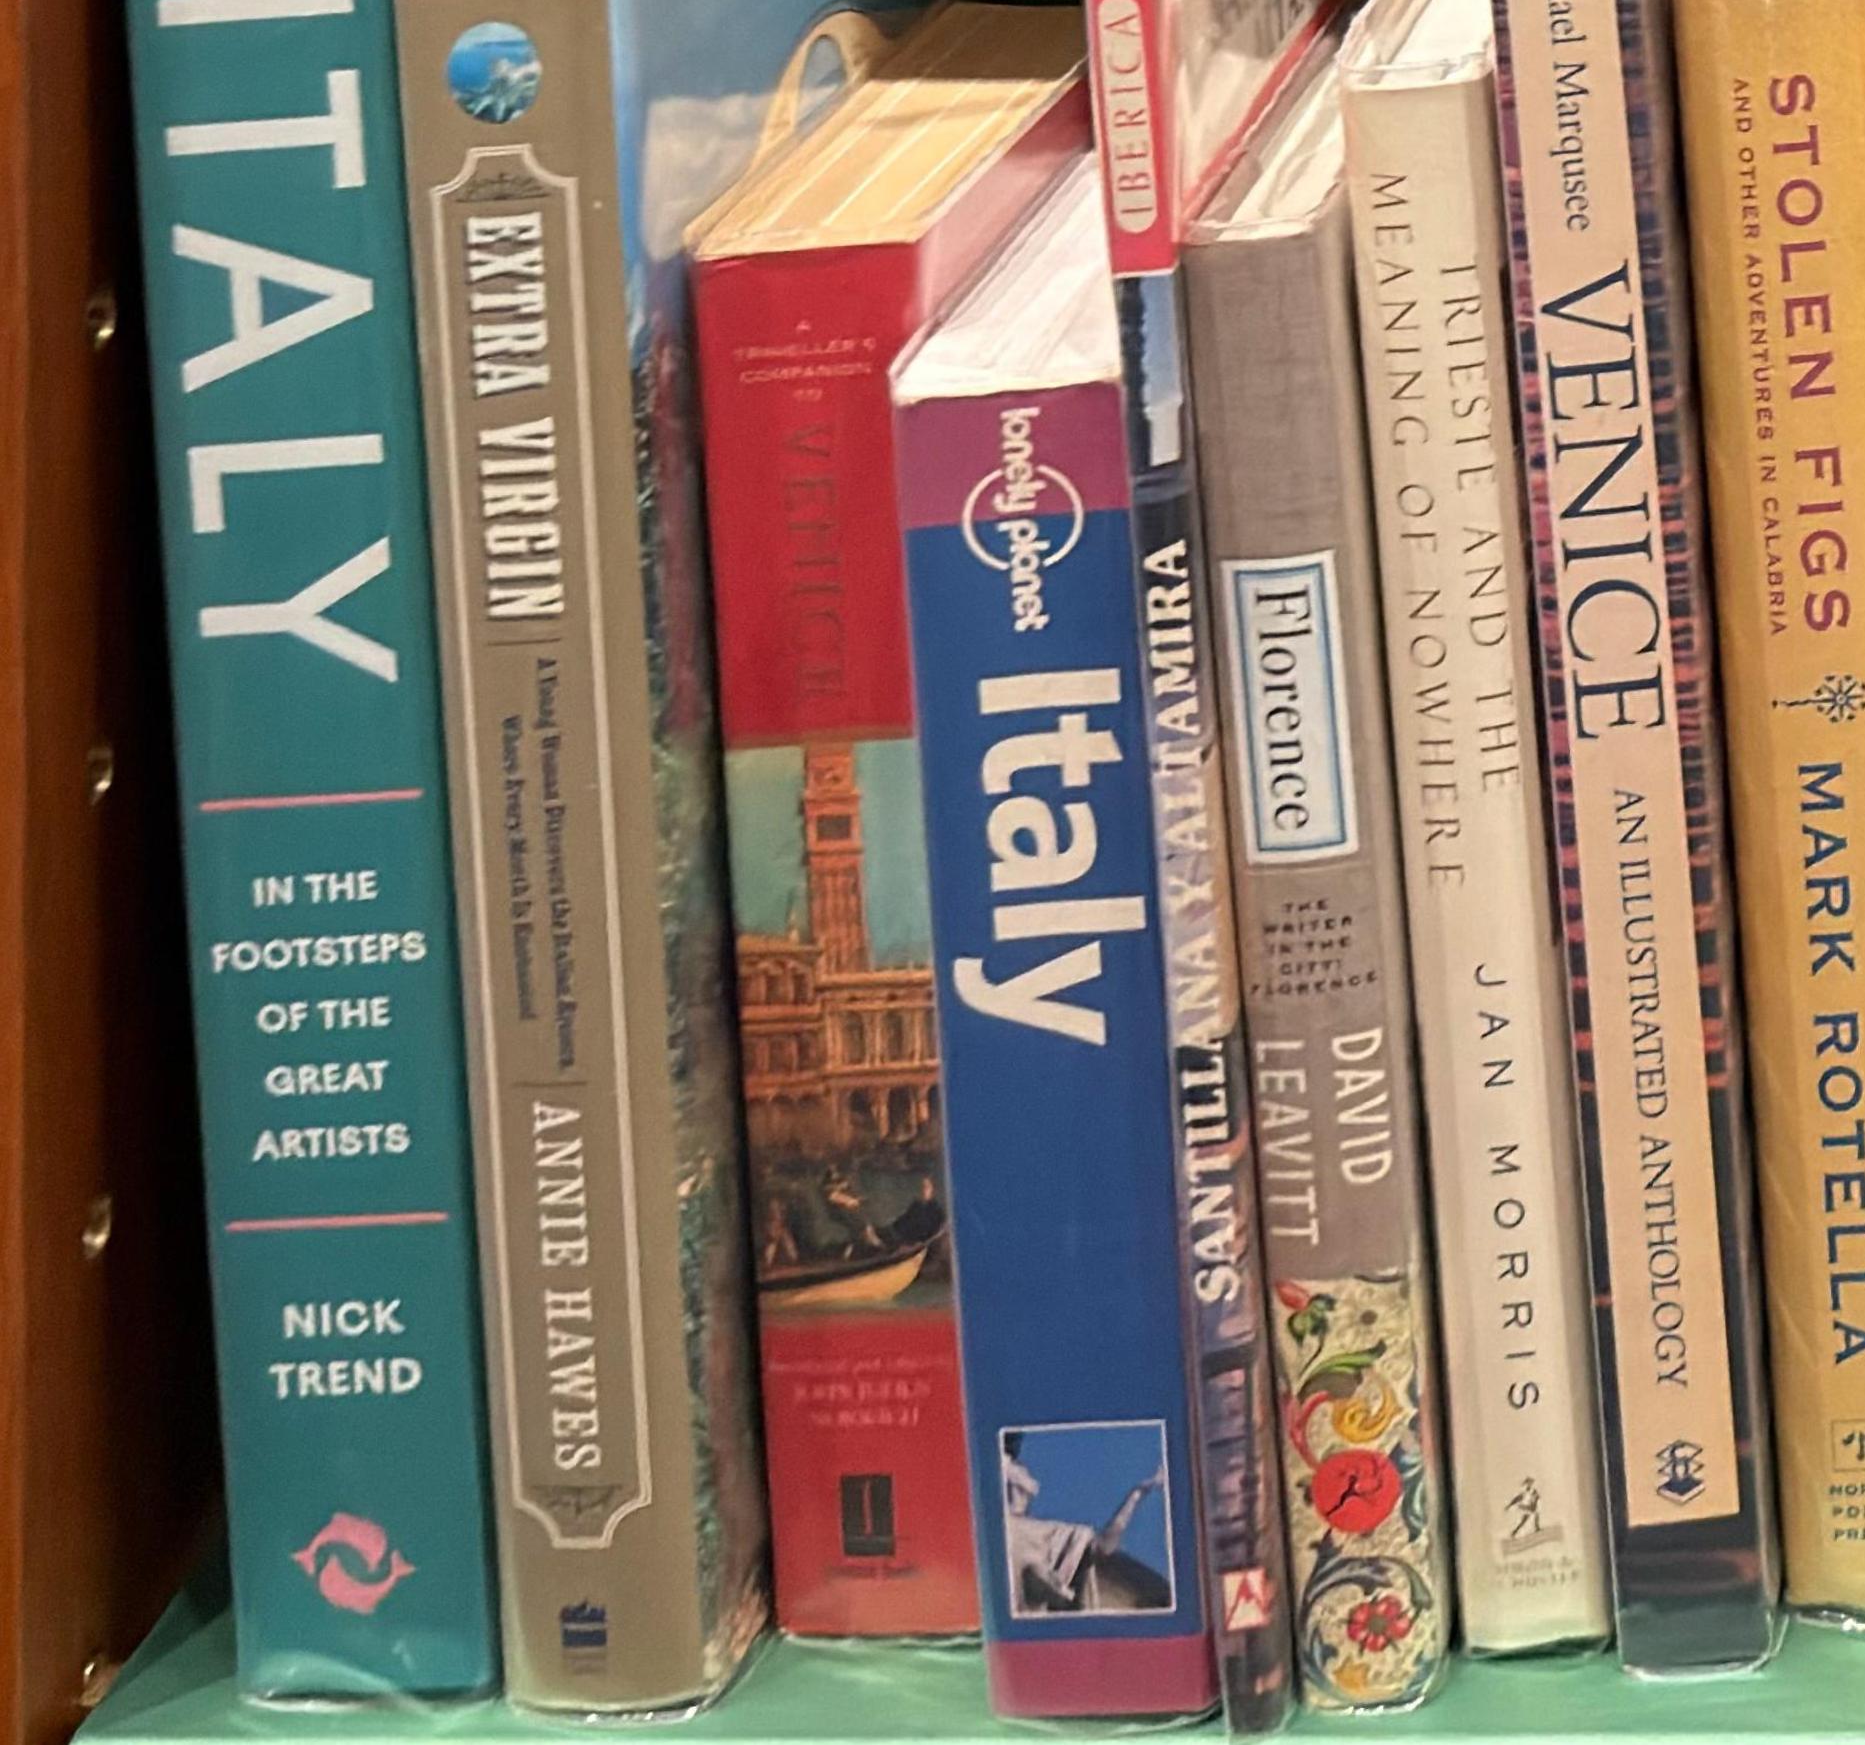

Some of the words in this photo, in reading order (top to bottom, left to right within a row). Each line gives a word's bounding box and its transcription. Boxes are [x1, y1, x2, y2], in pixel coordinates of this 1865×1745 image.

[1104, 12, 1157, 216] IBERICA
[1549, 61, 1592, 234] Marqusee
[1731, 78, 1753, 134] AND
[1737, 146, 1761, 240] OTHER
[464, 208, 550, 397] EXTRA
[1369, 173, 1429, 447] MEANING
[1768, 73, 1838, 401] STOLEN
[1440, 261, 1500, 493] TRIESTE
[1744, 256, 1777, 441] ADVENTURES
[477, 417, 565, 621] VIRGIN
[994, 407, 1042, 514] lonely
[1397, 483, 1438, 548] OF
[1540, 257, 1669, 741] VENICE
[1793, 445, 1852, 634] FIGS
[994, 520, 1049, 632] planet
[1463, 531, 1511, 648] AND
[1761, 497, 1789, 635] CALABRIA
[1141, 538, 1212, 852] ALTAMIRA
[1254, 586, 1314, 832] Florence
[1407, 586, 1466, 889] NOWHERE
[1474, 684, 1522, 794] THE
[253, 875, 298, 907] IN
[305, 870, 378, 904] THE
[953, 669, 1147, 1047] Italy
[1612, 787, 1648, 847] AN
[1799, 761, 1856, 976] MARK
[212, 930, 427, 974] FOOTSTEPS
[256, 1001, 305, 1034] OF
[315, 997, 392, 1031] THE
[1474, 962, 1514, 1090] JAN
[1619, 858, 1669, 1121] ILLUSTRATED
[252, 1121, 412, 1162] ARTISTS
[265, 1059, 389, 1097] GREAT
[1167, 932, 1244, 1305] SANTILLANA
[1256, 1039, 1320, 1247] LEAVITT
[1331, 1026, 1394, 1185] DAVID
[534, 1100, 590, 1268] ANNIE
[1638, 1133, 1688, 1391] ANTHOLOGY
[282, 1300, 405, 1342] NICK
[1487, 1143, 1541, 1412] MORRIS
[269, 1357, 422, 1400] TREND
[545, 1287, 603, 1472] HAWES
